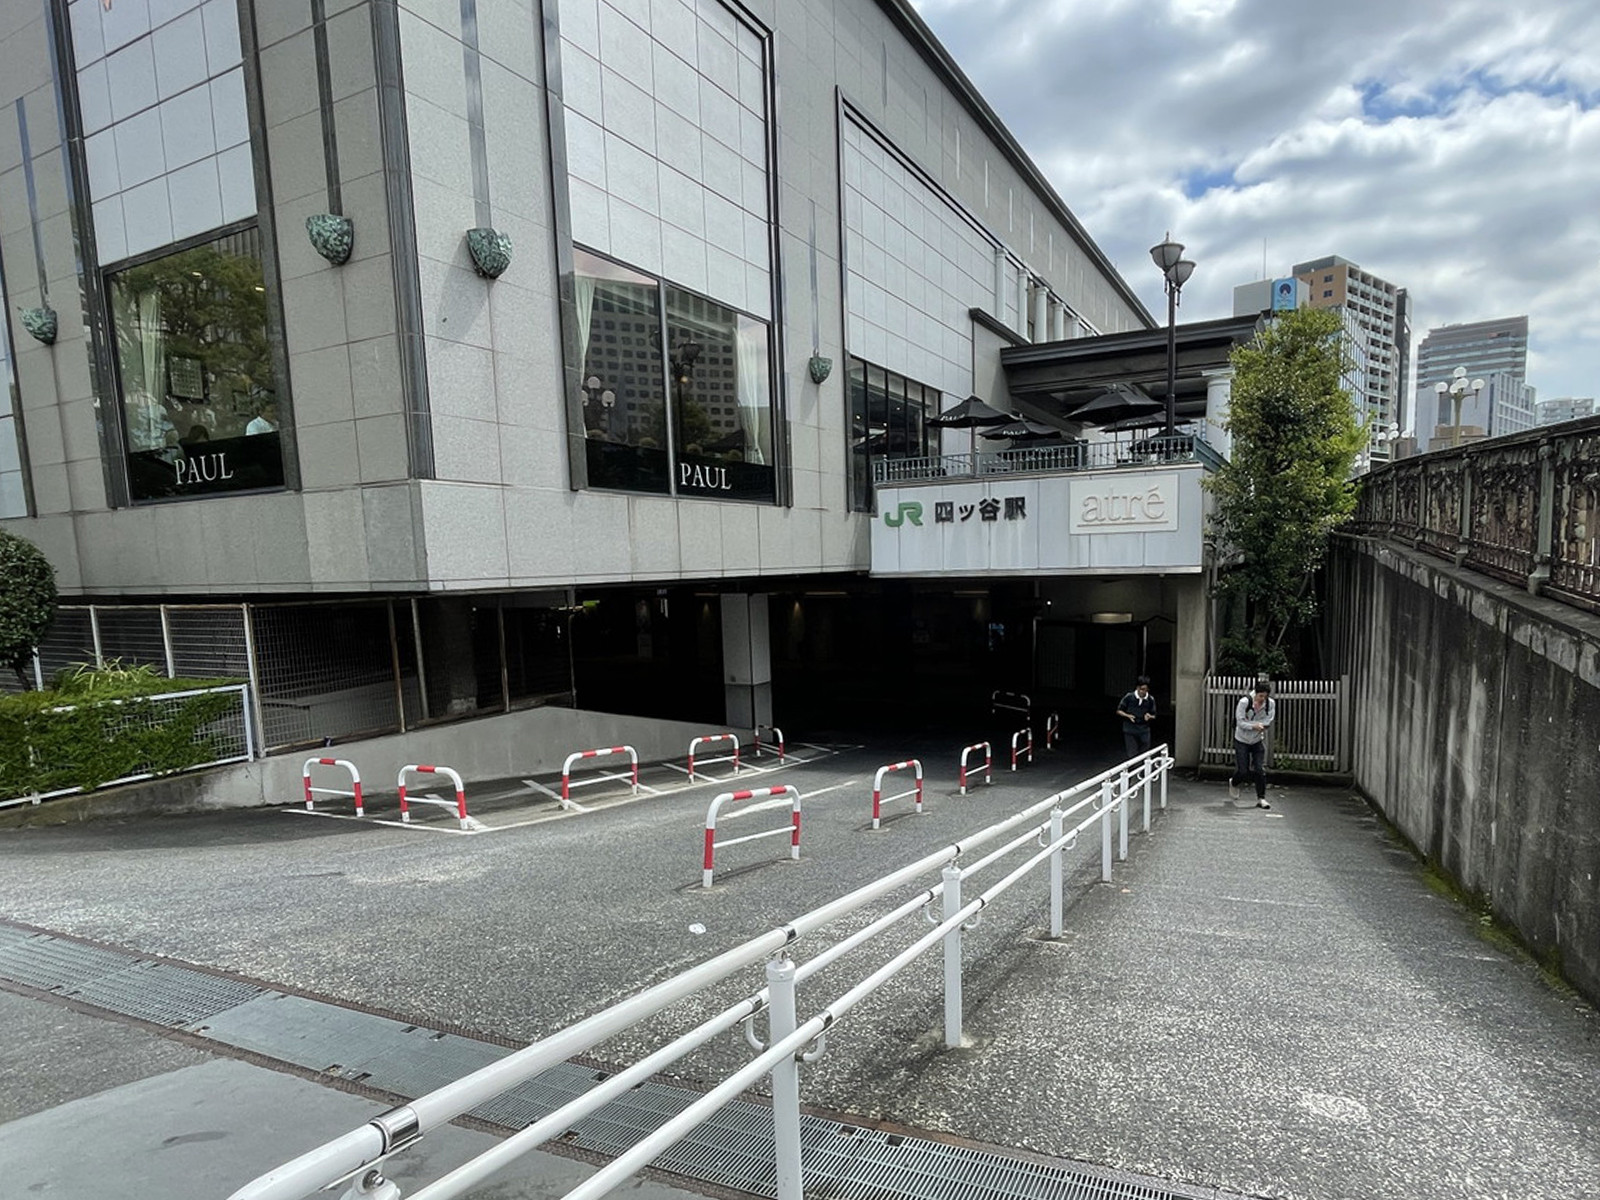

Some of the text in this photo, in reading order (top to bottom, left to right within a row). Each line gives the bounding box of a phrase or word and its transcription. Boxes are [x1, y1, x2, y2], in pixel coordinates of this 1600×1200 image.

[174, 452, 234, 486] PAUL
[680, 462, 732, 490] PAUL
[884, 501, 923, 527] JR
[1081, 485, 1165, 523] atré
